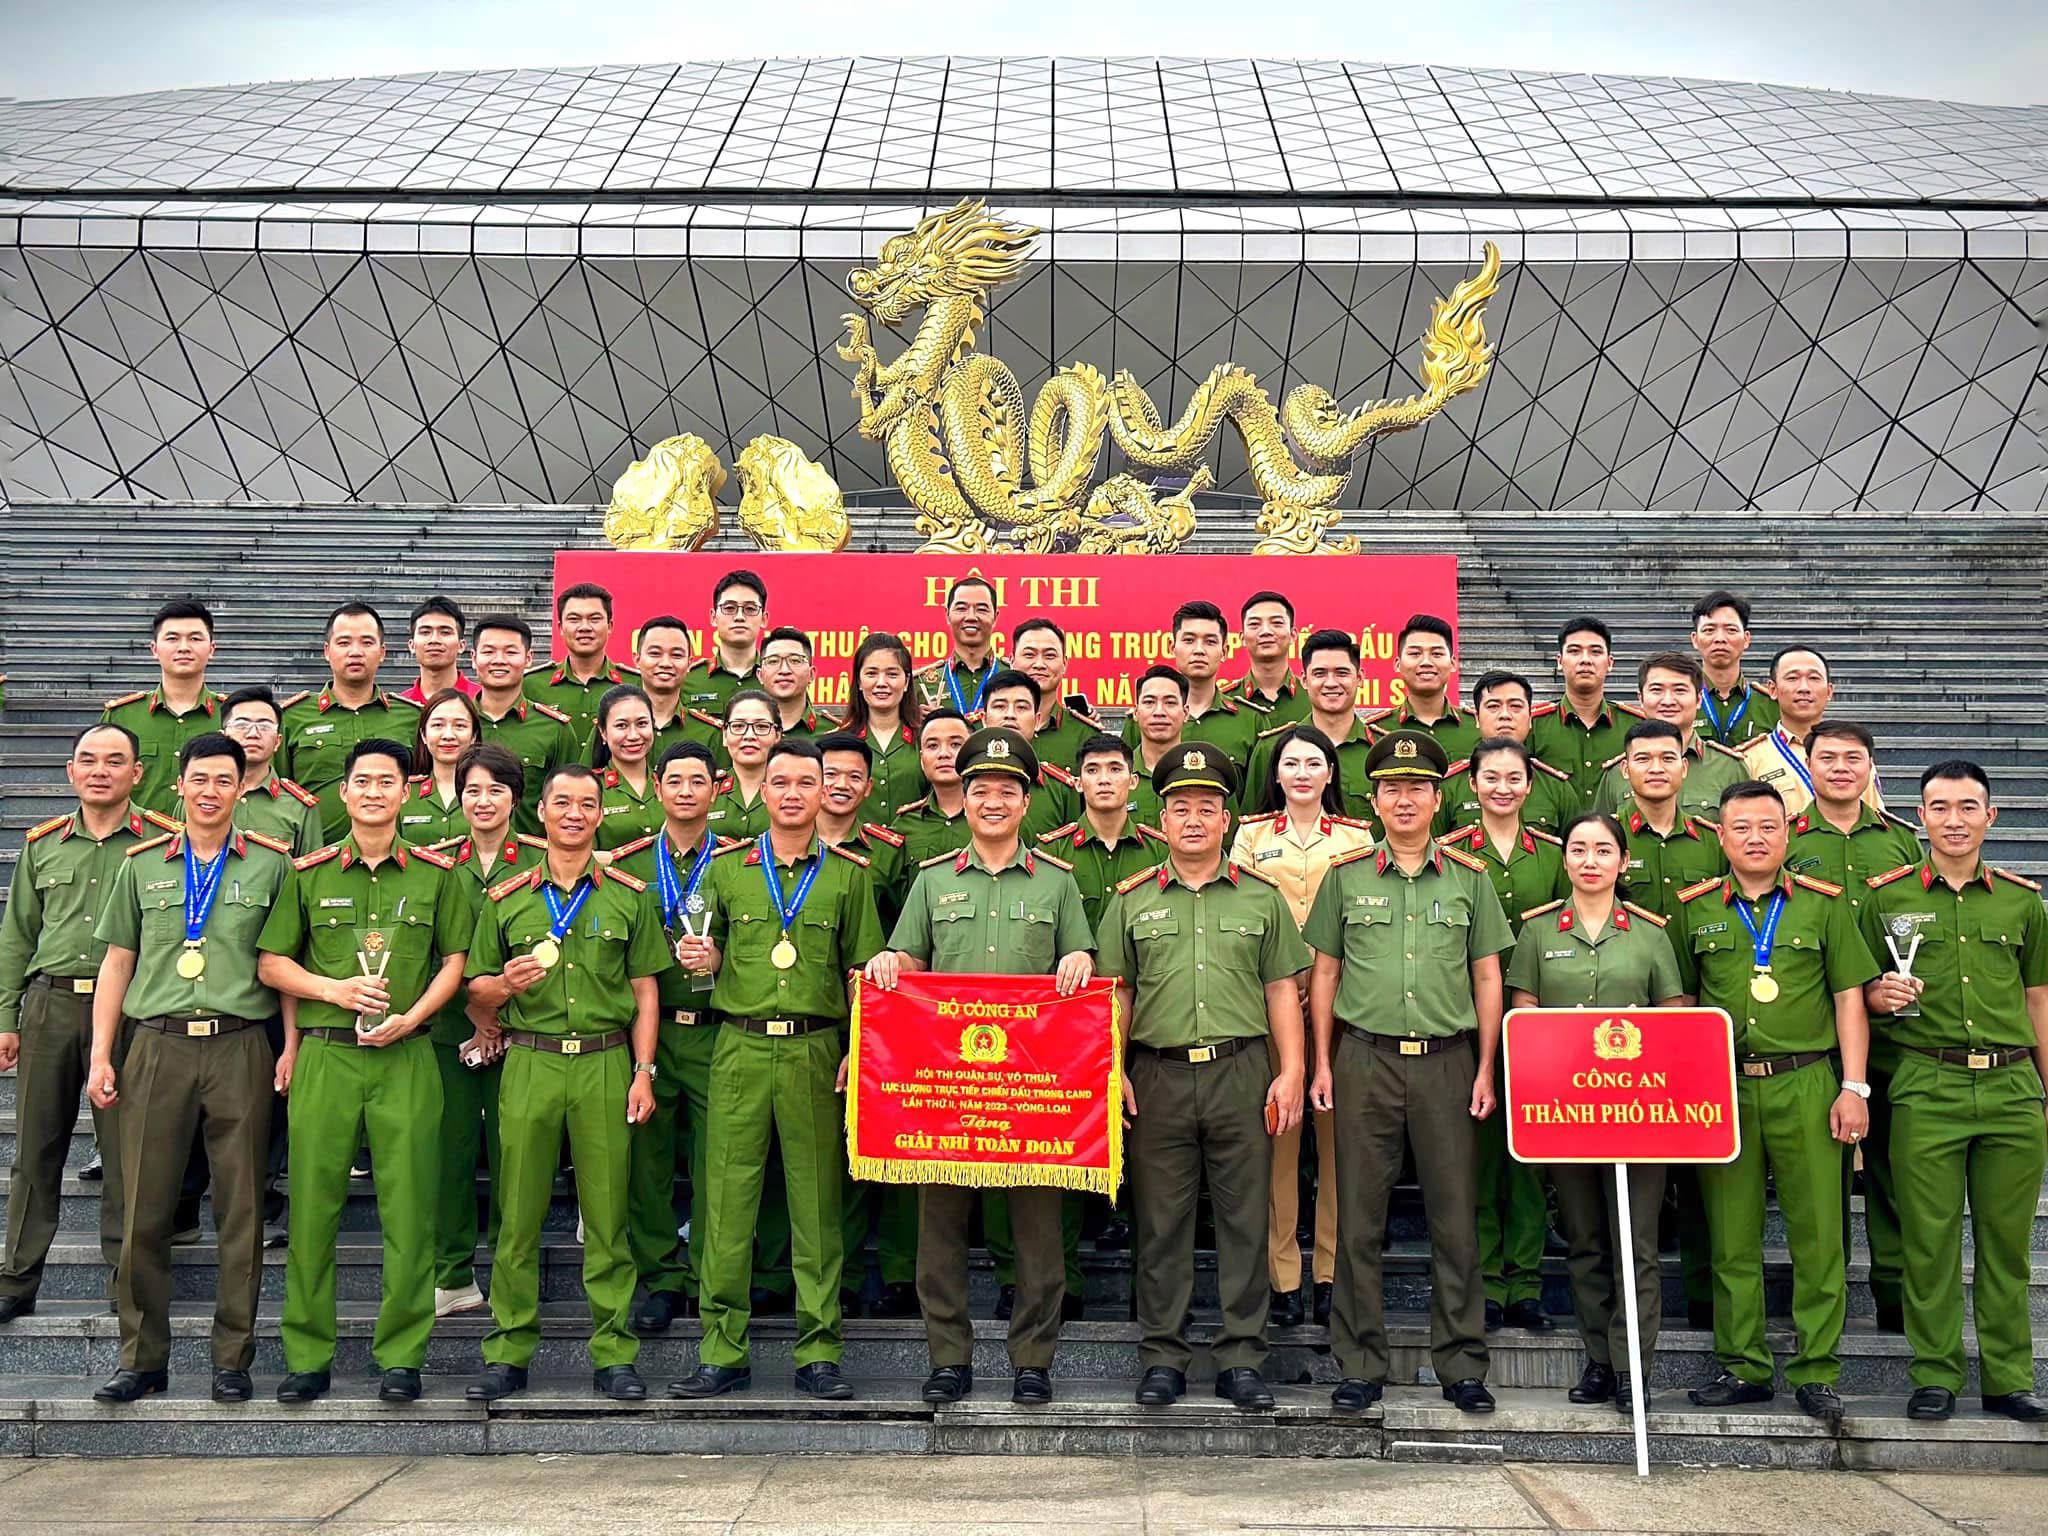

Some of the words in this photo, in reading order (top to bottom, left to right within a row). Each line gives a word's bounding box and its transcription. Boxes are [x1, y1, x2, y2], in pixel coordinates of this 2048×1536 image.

[924, 567, 1008, 607] HI
[1020, 577, 1101, 607] THI
[1351, 623, 1393, 659] ẤU
[1097, 672, 1133, 704] NĂ
[938, 997, 959, 1019] BỘ
[963, 998, 1009, 1018] CÔNG
[1015, 1004, 1038, 1020] AN
[936, 1070, 953, 1079] THI
[955, 1069, 985, 1080] QUÂN
[1572, 1068, 1633, 1088] CÔNG
[1638, 1072, 1667, 1088] AN
[960, 1114, 1012, 1131] Tặng
[1521, 1098, 1596, 1124] THÀNH
[1601, 1098, 1645, 1124] PHỐ
[1649, 1098, 1680, 1124] HÀ
[1684, 1100, 1723, 1129] NỘI
[895, 1130, 933, 1150] GIẢI
[939, 1132, 969, 1150] NHÌ
[975, 1134, 1021, 1153] TOÀN
